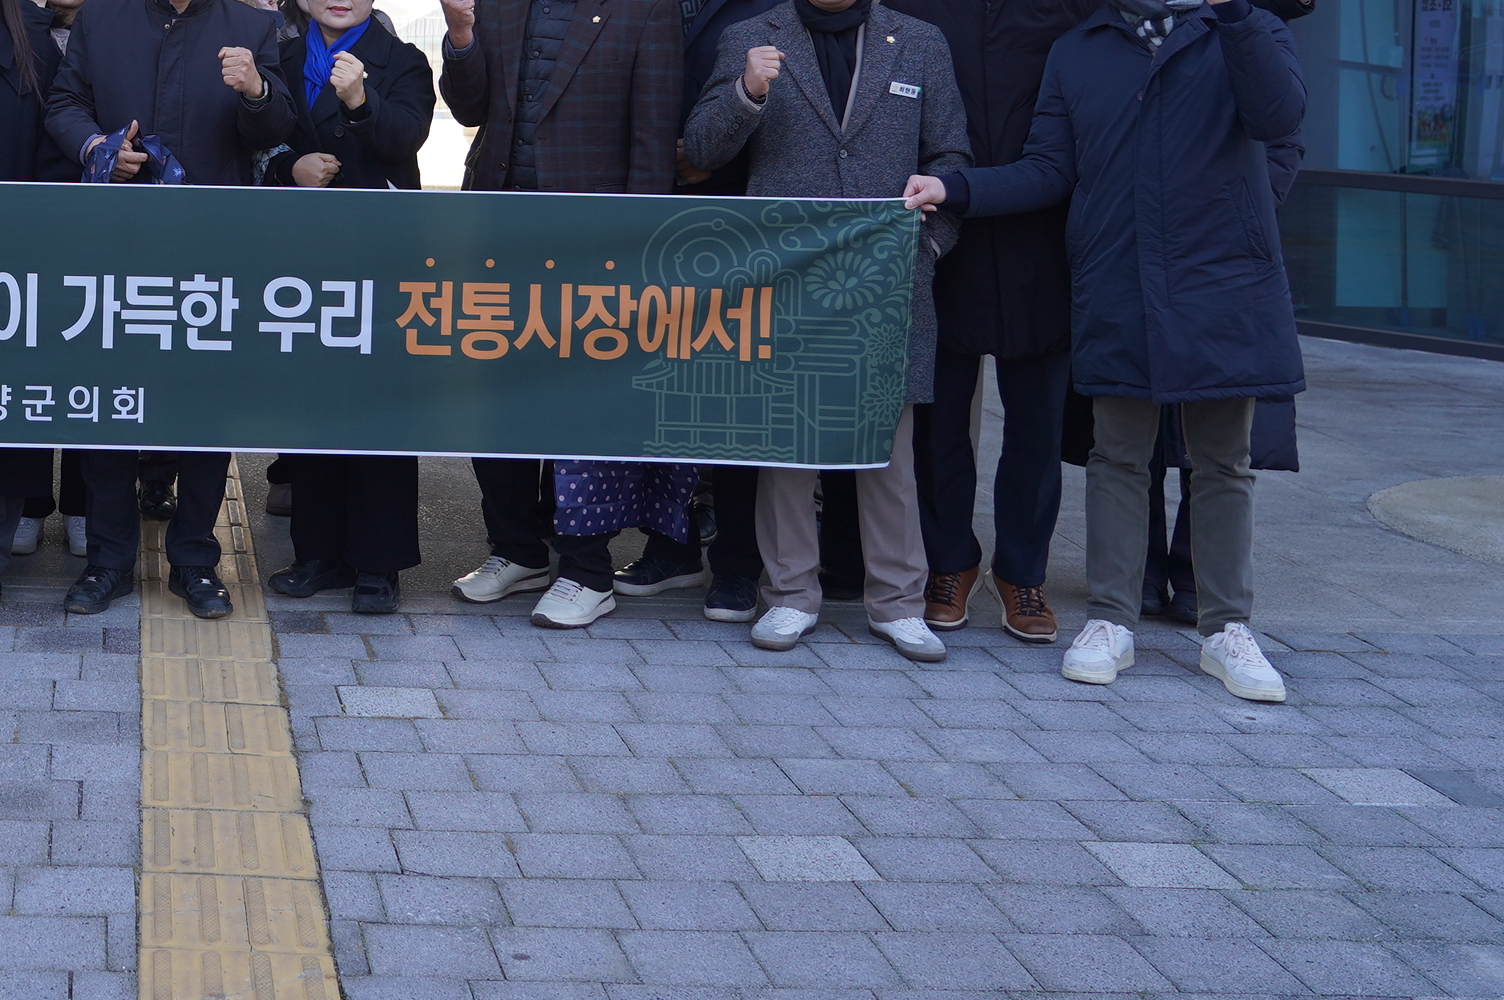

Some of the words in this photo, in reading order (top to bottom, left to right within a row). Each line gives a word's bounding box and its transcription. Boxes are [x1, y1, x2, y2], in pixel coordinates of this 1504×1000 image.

[60, 273, 240, 352] 가득한
[258, 276, 374, 355] 우리
[395, 281, 773, 362] 전통시장에서!
